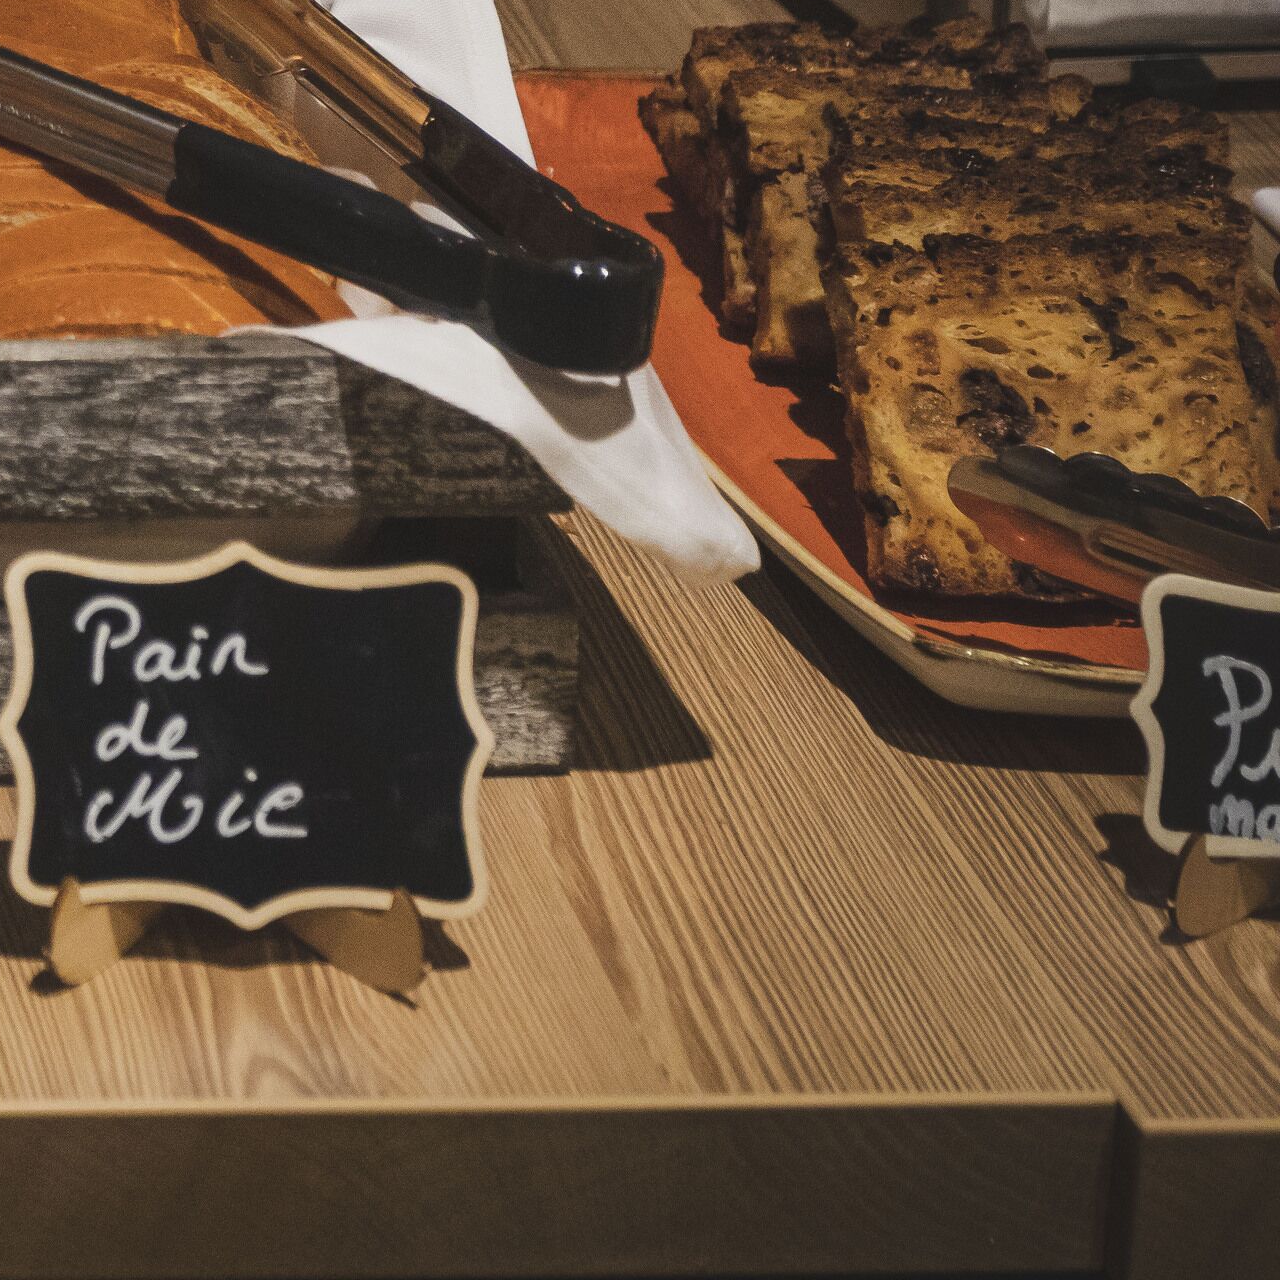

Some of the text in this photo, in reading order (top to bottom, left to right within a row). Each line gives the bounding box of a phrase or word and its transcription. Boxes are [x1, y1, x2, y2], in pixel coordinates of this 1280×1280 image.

[73, 594, 270, 686] Pain
[94, 699, 200, 762] de
[83, 767, 309, 845] Mie
